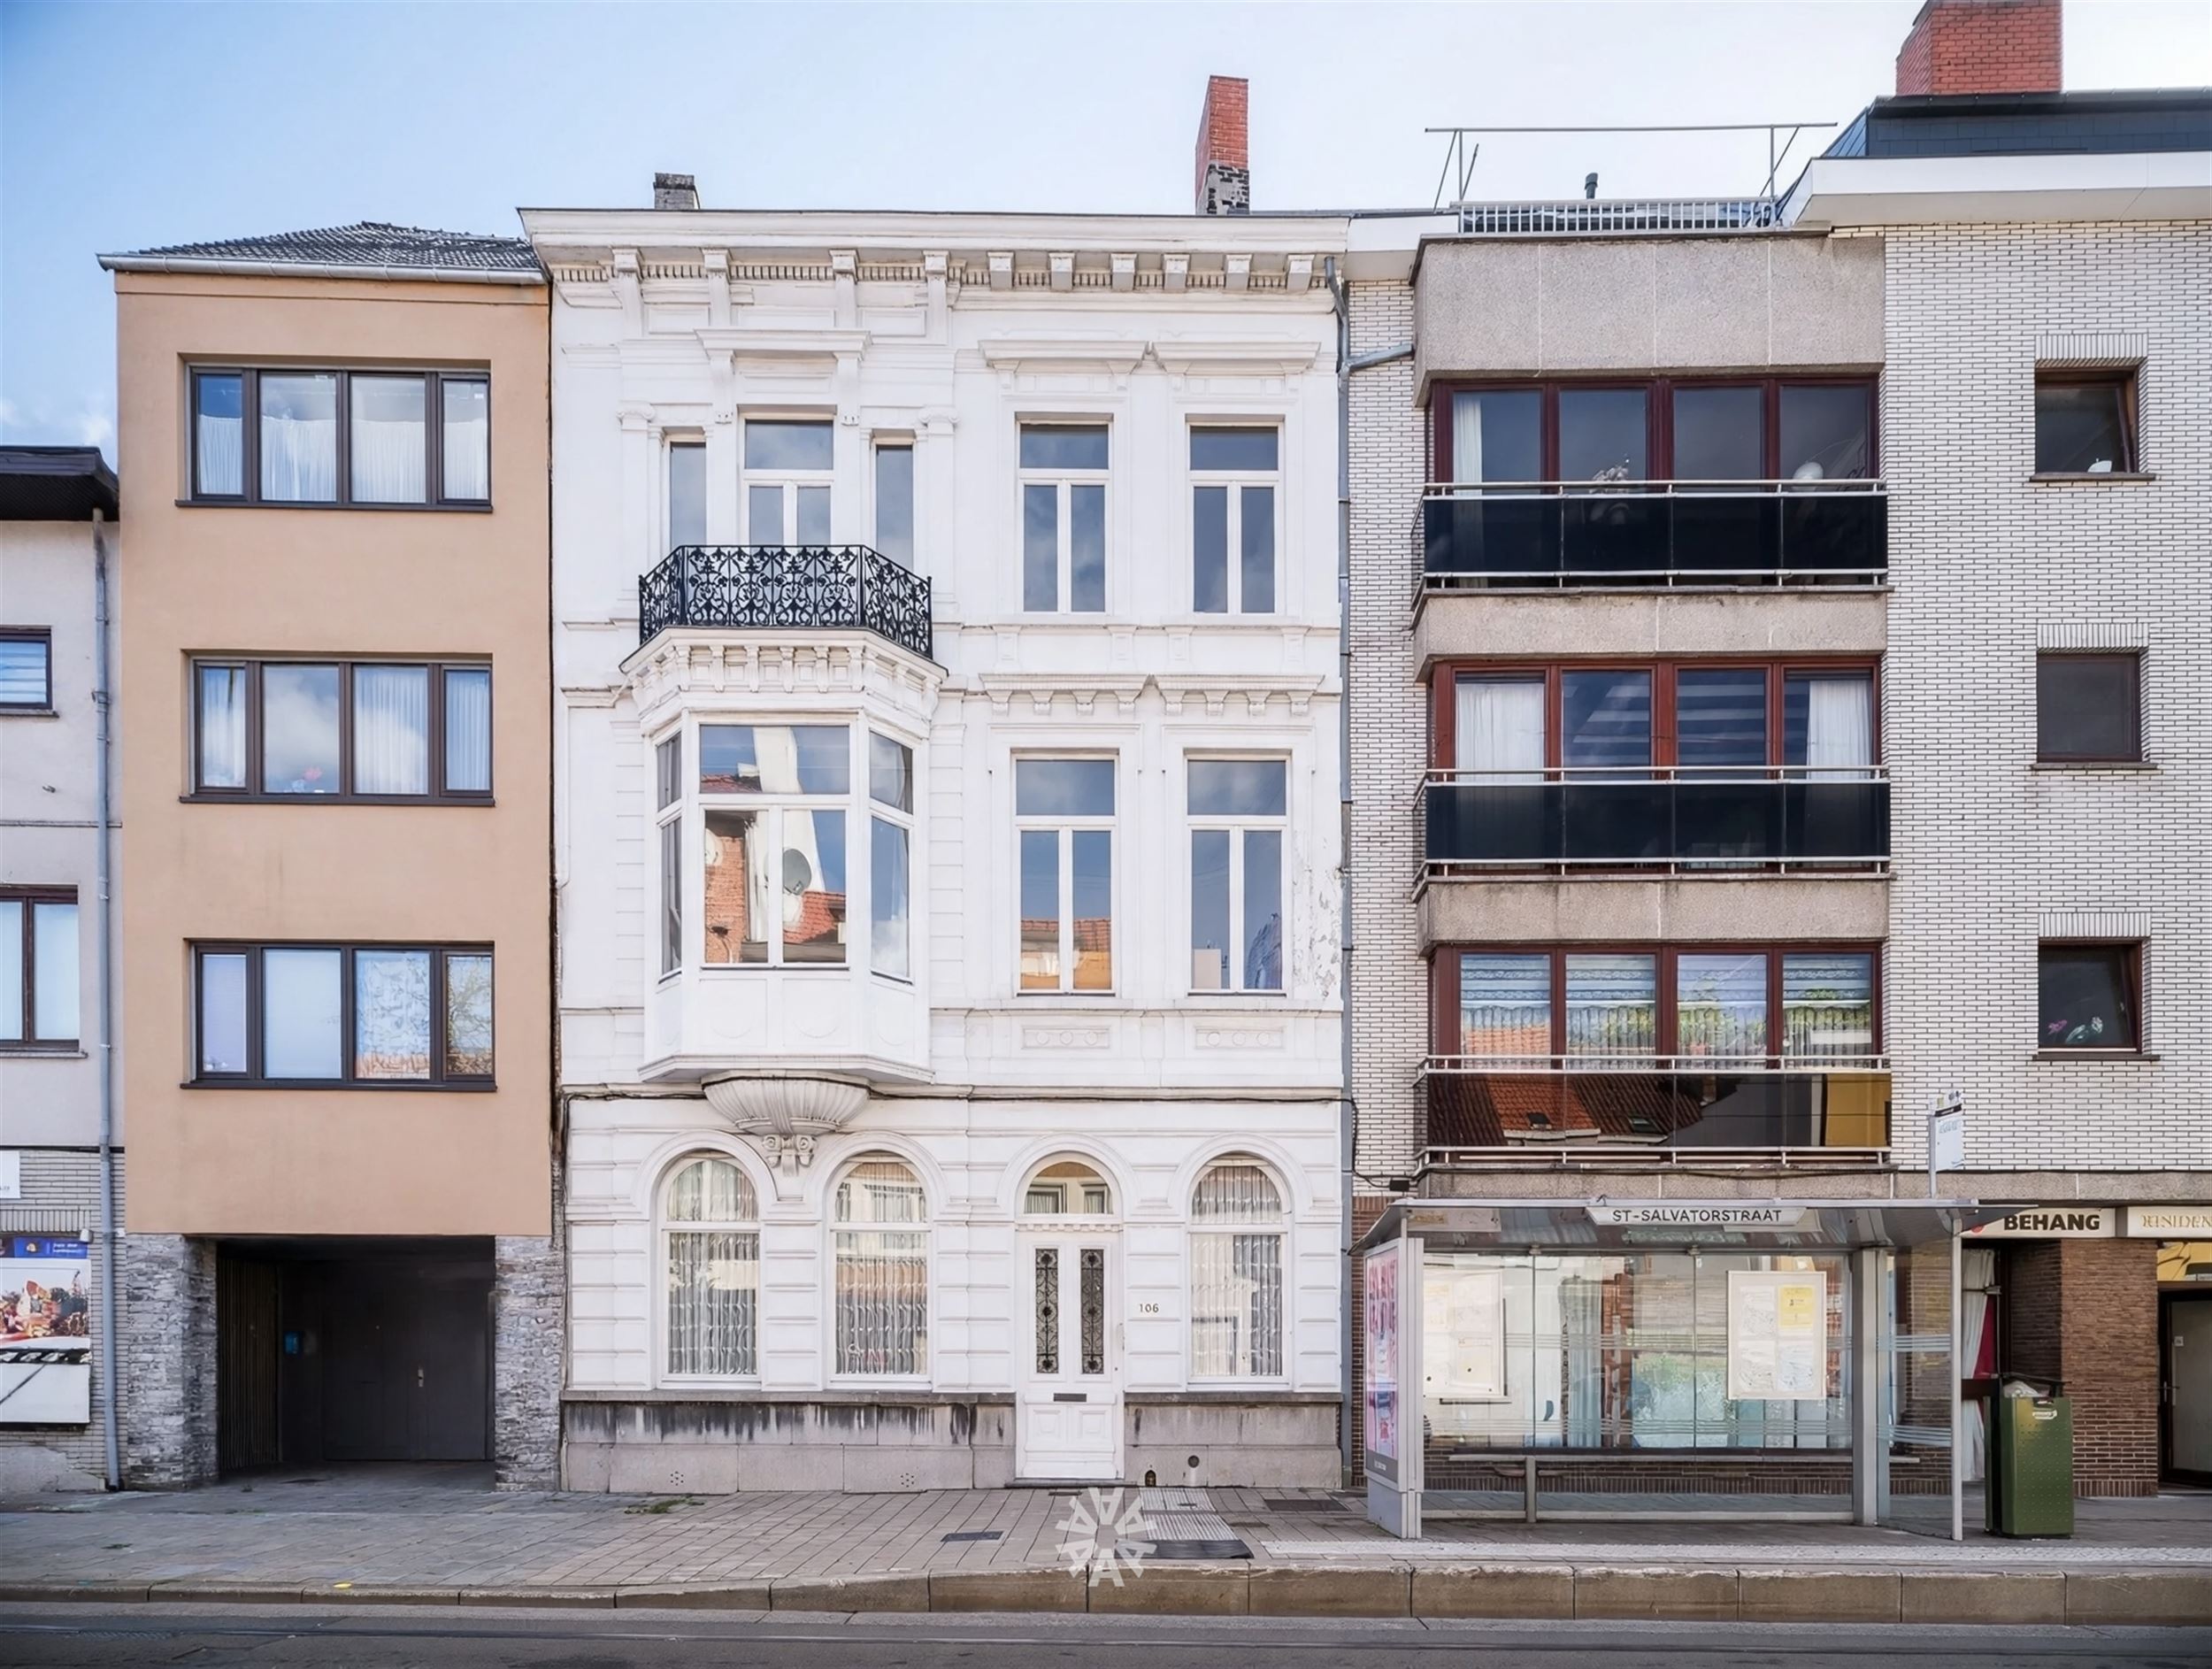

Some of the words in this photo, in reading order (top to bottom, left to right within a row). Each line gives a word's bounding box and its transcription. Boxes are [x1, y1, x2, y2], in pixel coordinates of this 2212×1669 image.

[1612, 1209, 1782, 1222] ST-SALVATORSTRAAT
[2004, 1214, 2101, 1231] BEHANG
[1140, 1303, 1160, 1313] 106
